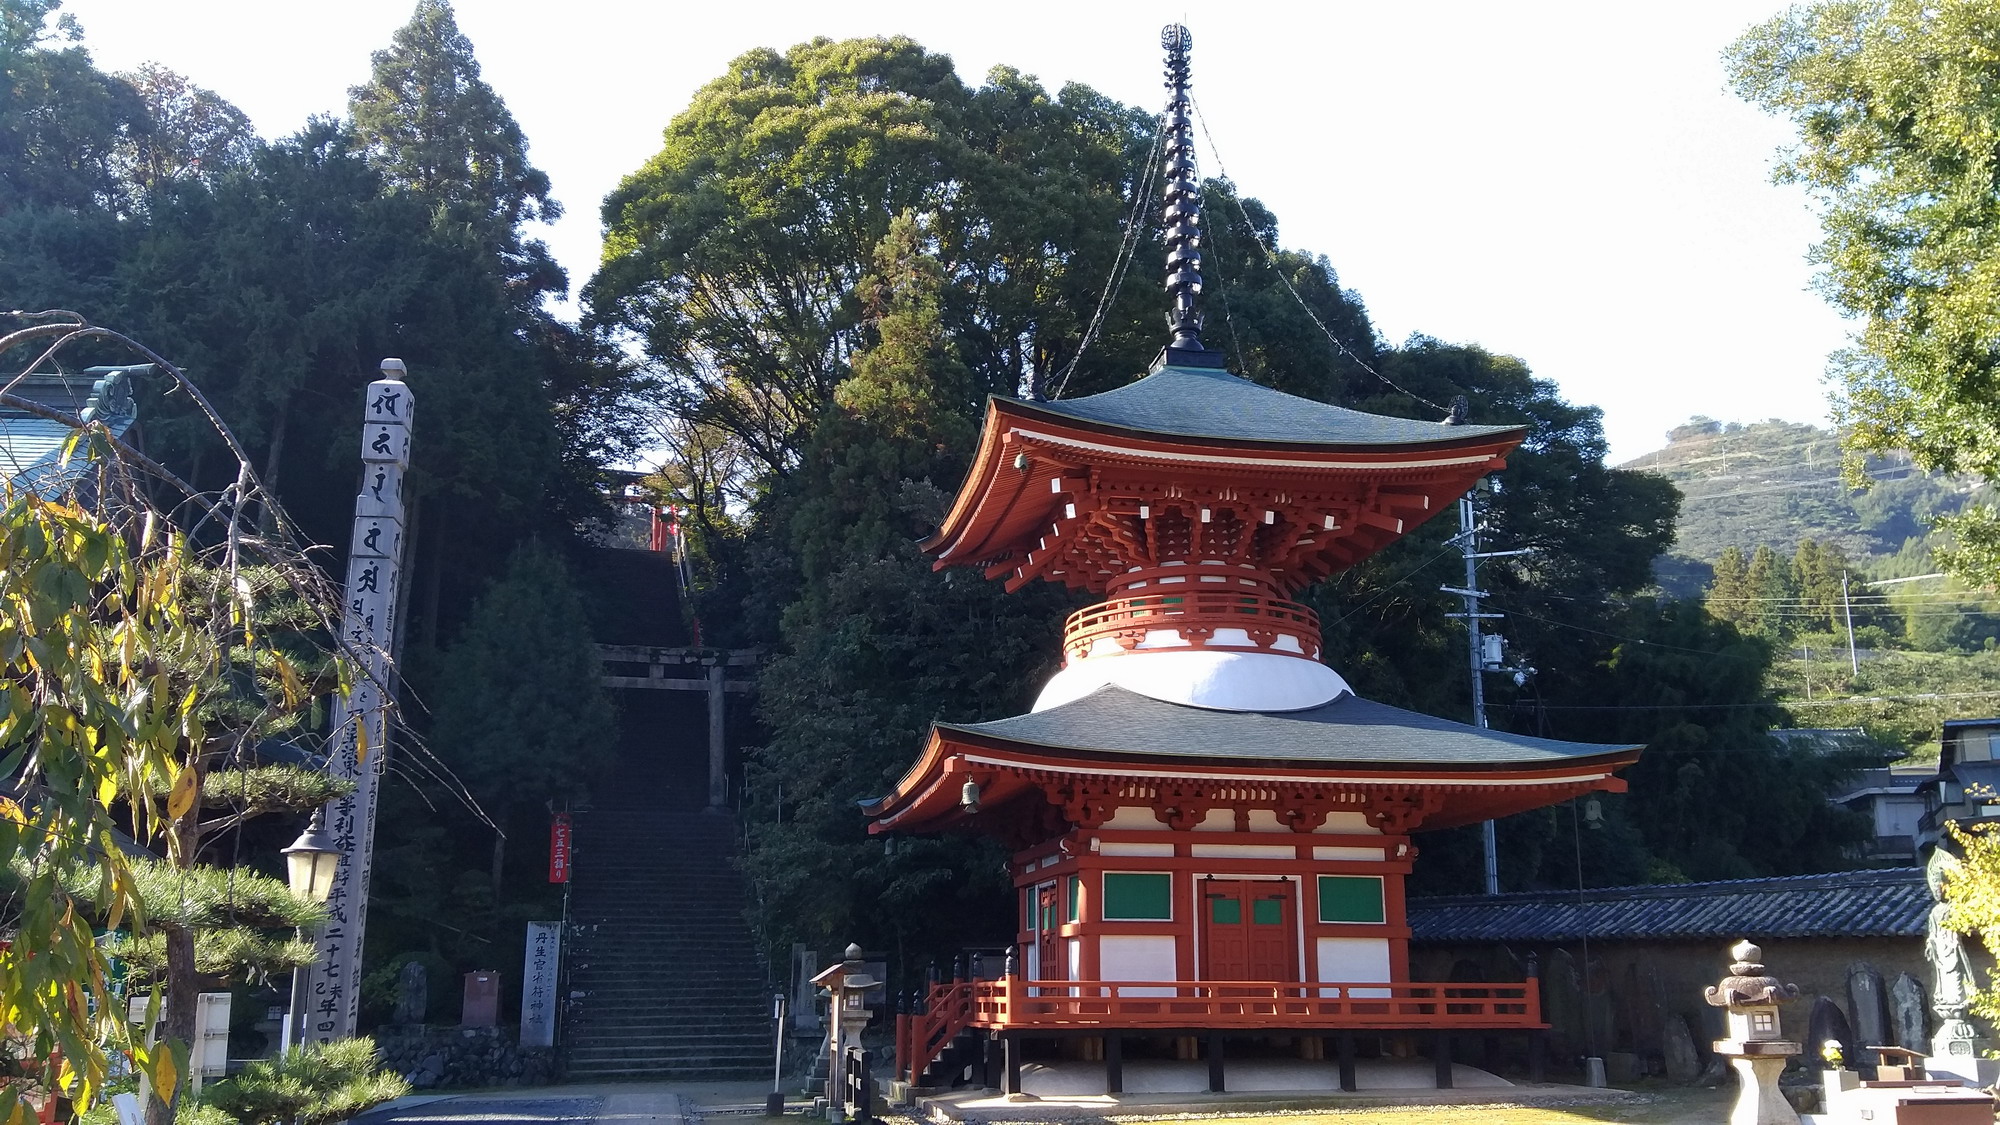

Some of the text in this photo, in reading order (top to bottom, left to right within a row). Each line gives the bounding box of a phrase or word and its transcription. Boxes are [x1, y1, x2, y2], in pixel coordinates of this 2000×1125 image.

[529, 932, 547, 1024] 丹生官省符神社
